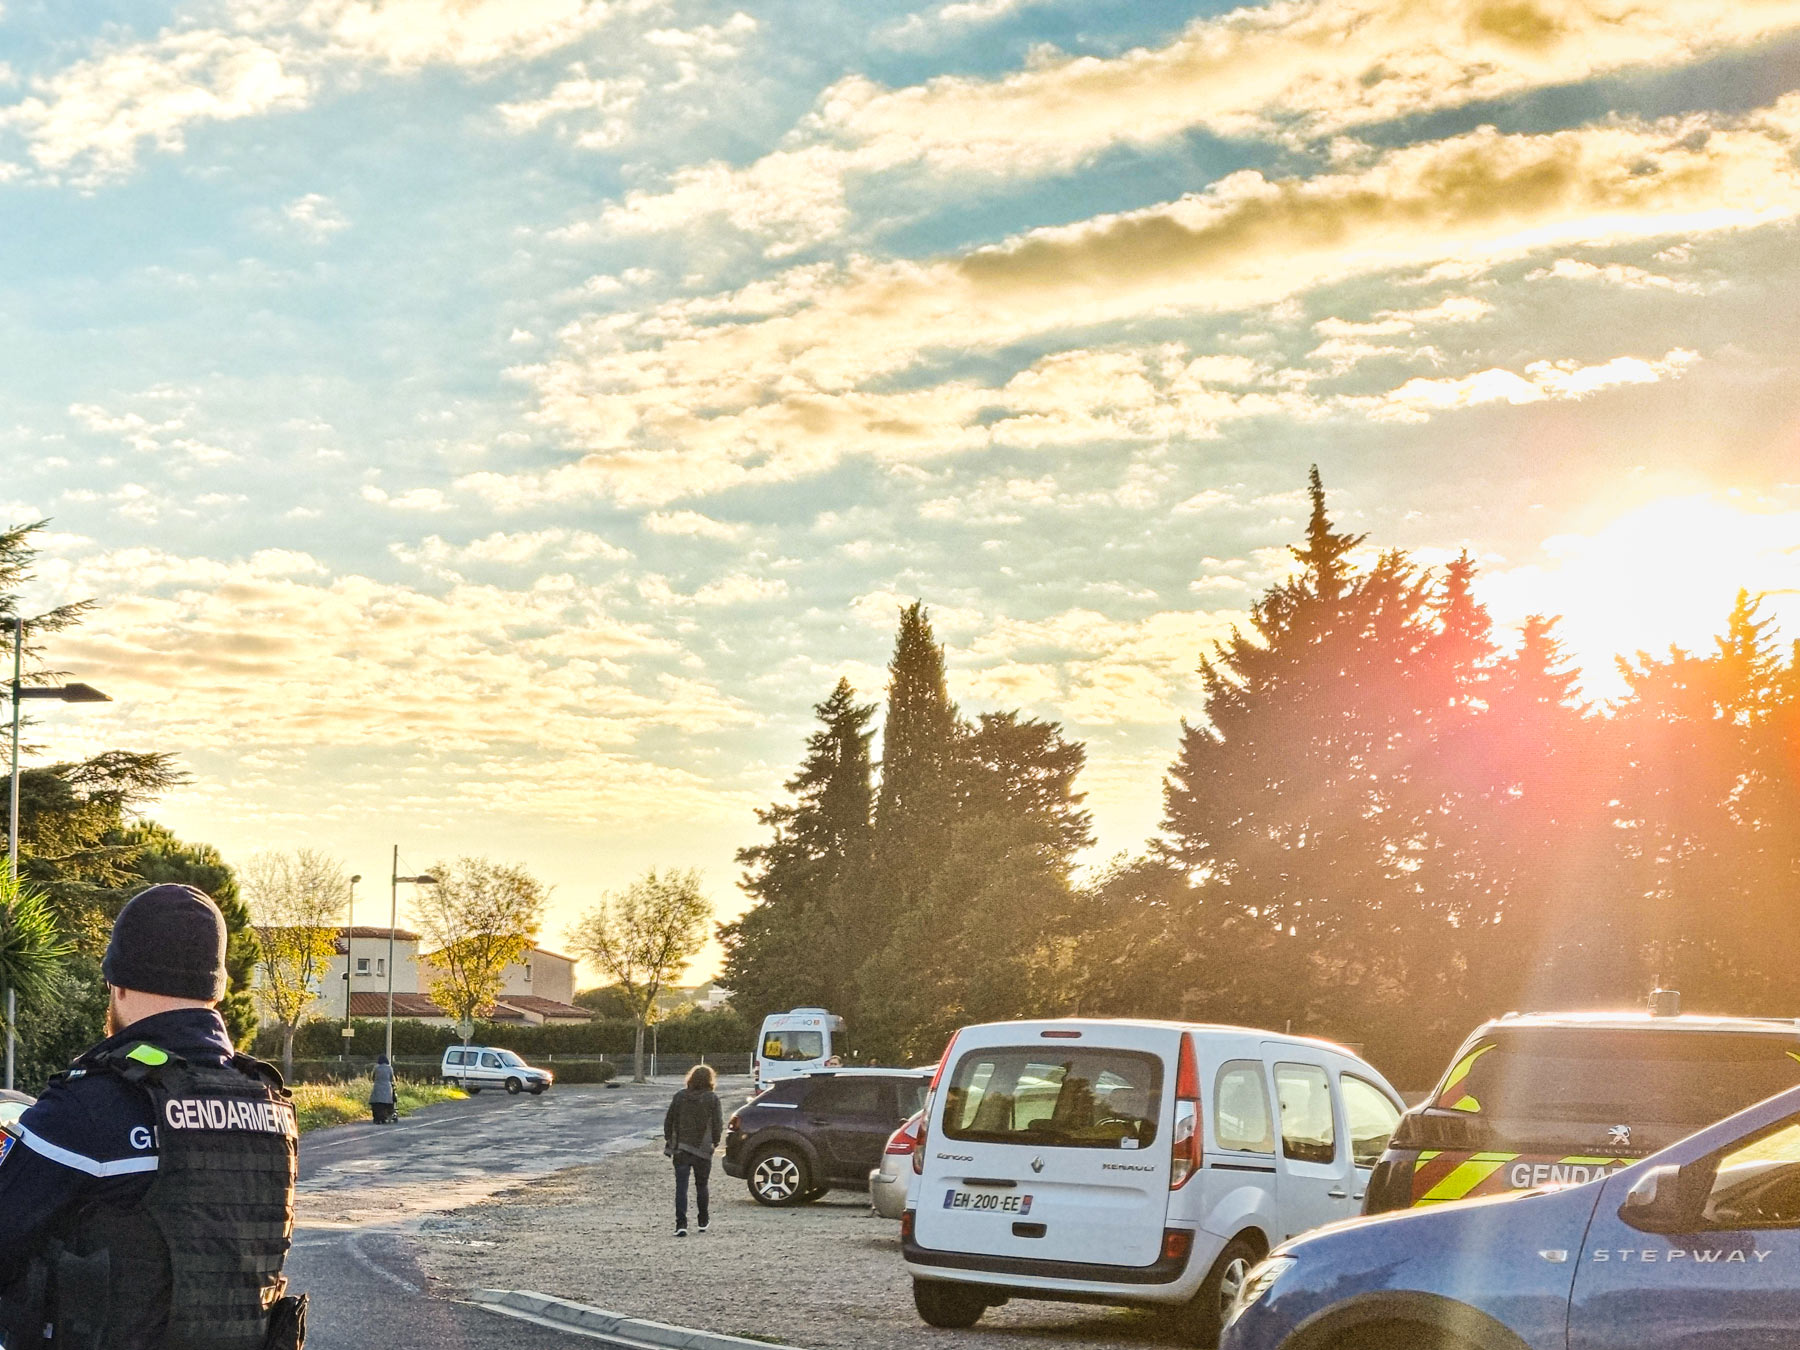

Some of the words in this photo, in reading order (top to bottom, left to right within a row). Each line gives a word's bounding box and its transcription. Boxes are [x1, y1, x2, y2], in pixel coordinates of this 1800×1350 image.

[165, 1099, 298, 1138] GENDARMERIE
[1510, 1163, 1625, 1189] GENDA
[953, 1192, 1021, 1212] EH-200-EE
[1592, 1248, 1773, 1263] STEPWAY
